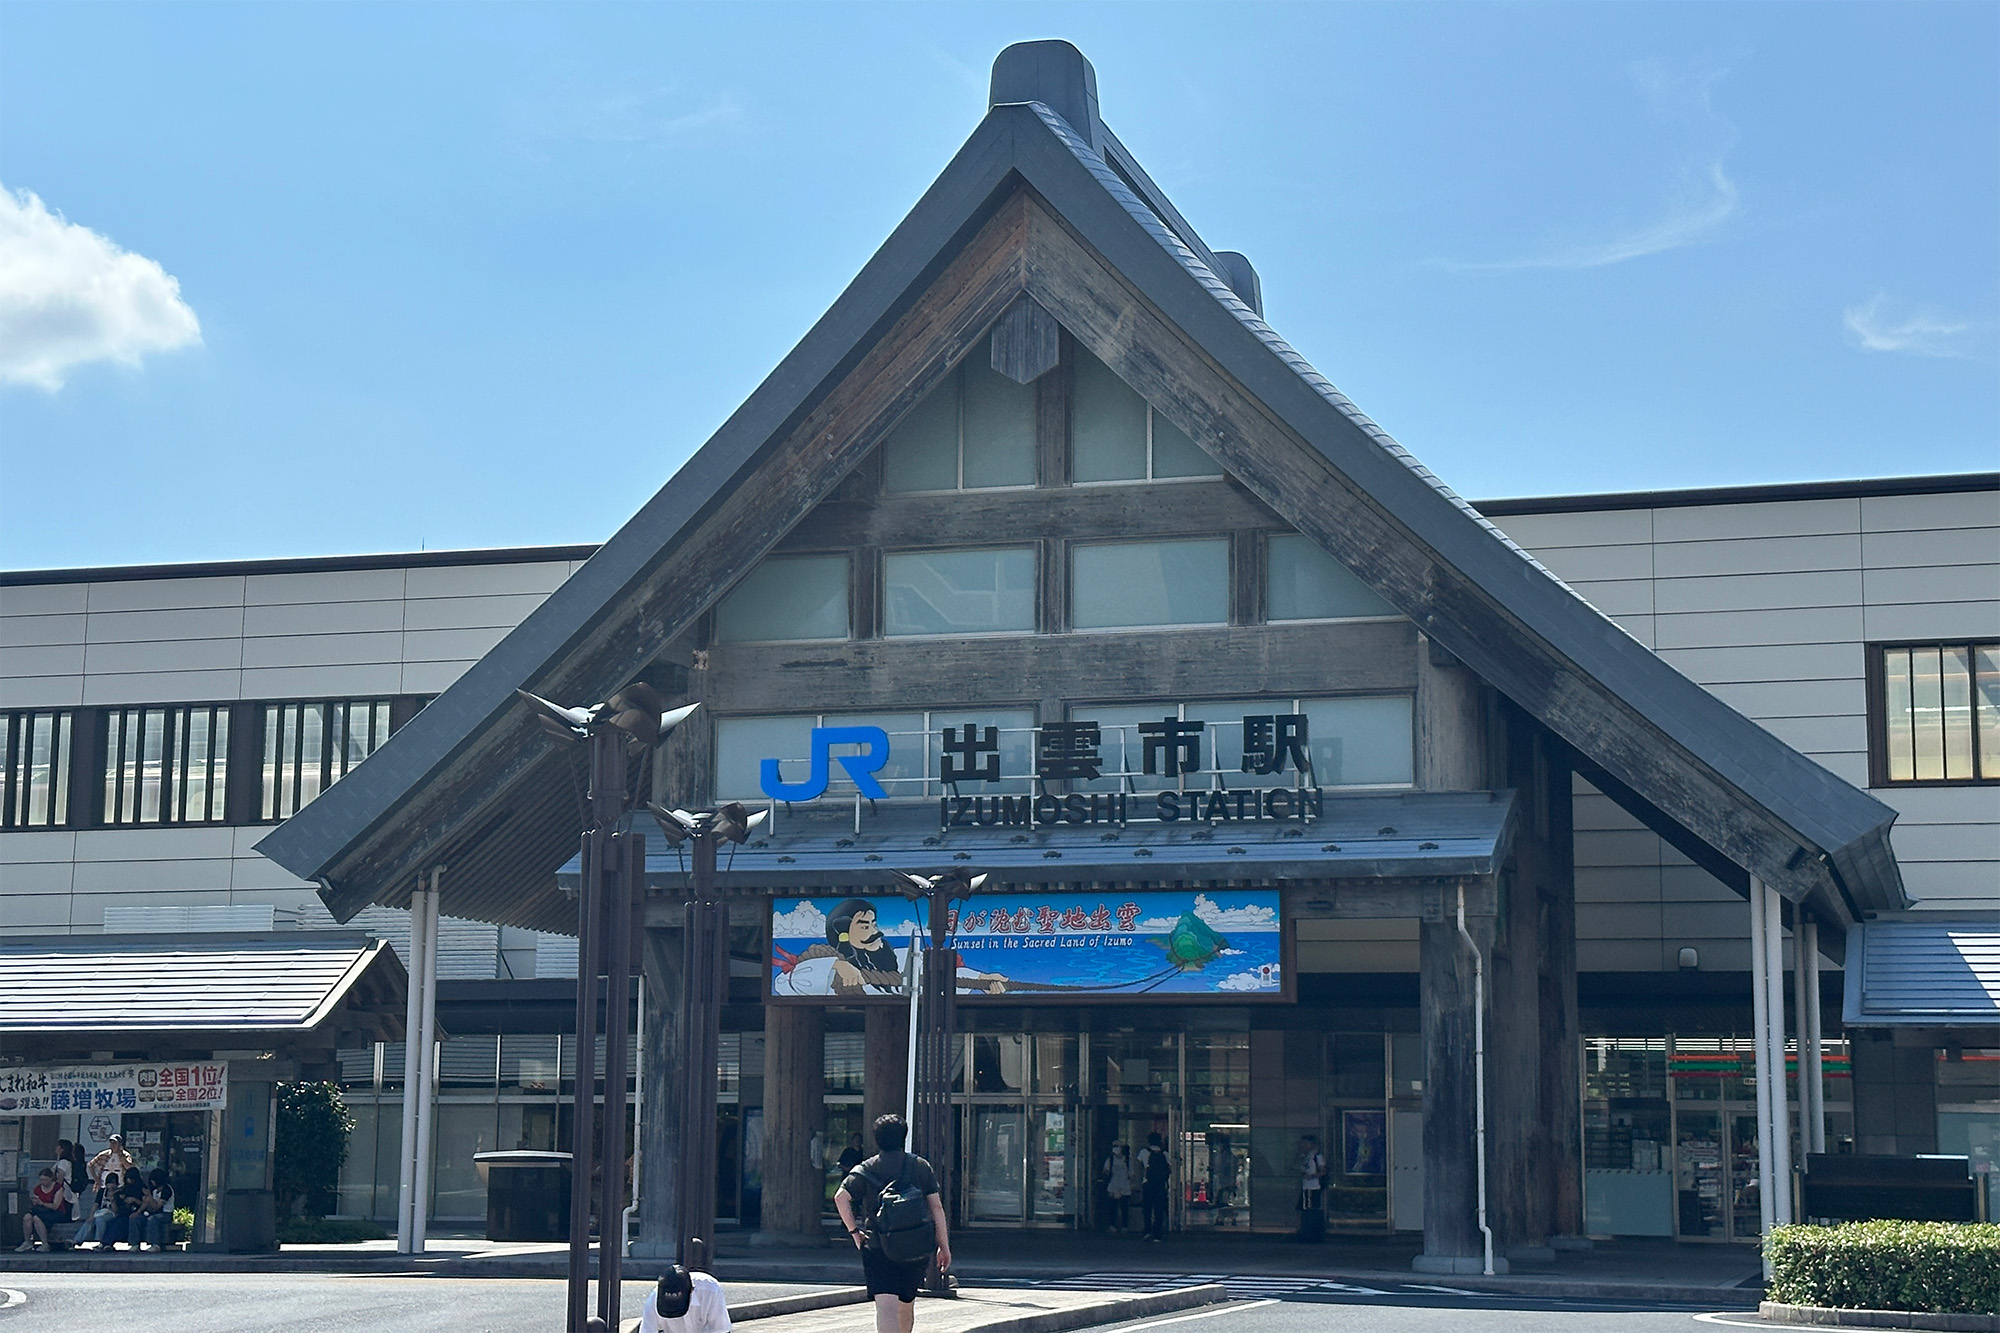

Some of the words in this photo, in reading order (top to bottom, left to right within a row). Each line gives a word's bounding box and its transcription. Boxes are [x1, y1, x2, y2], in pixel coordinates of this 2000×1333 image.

[760, 726, 889, 800] JR
[940, 714, 1310, 783] 出雲市駅
[941, 793, 1127, 828] IZUMOSHI
[1156, 788, 1323, 822] STATION
[951, 938, 985, 950] Sunset
[989, 938, 999, 949] in
[1003, 937, 1019, 949] the
[1022, 935, 1056, 948] Sacred
[1060, 935, 1086, 948] Land
[1089, 934, 1101, 948] of
[1103, 935, 1133, 947] Izumo
[50, 1088, 137, 1110] 藤増牧場
